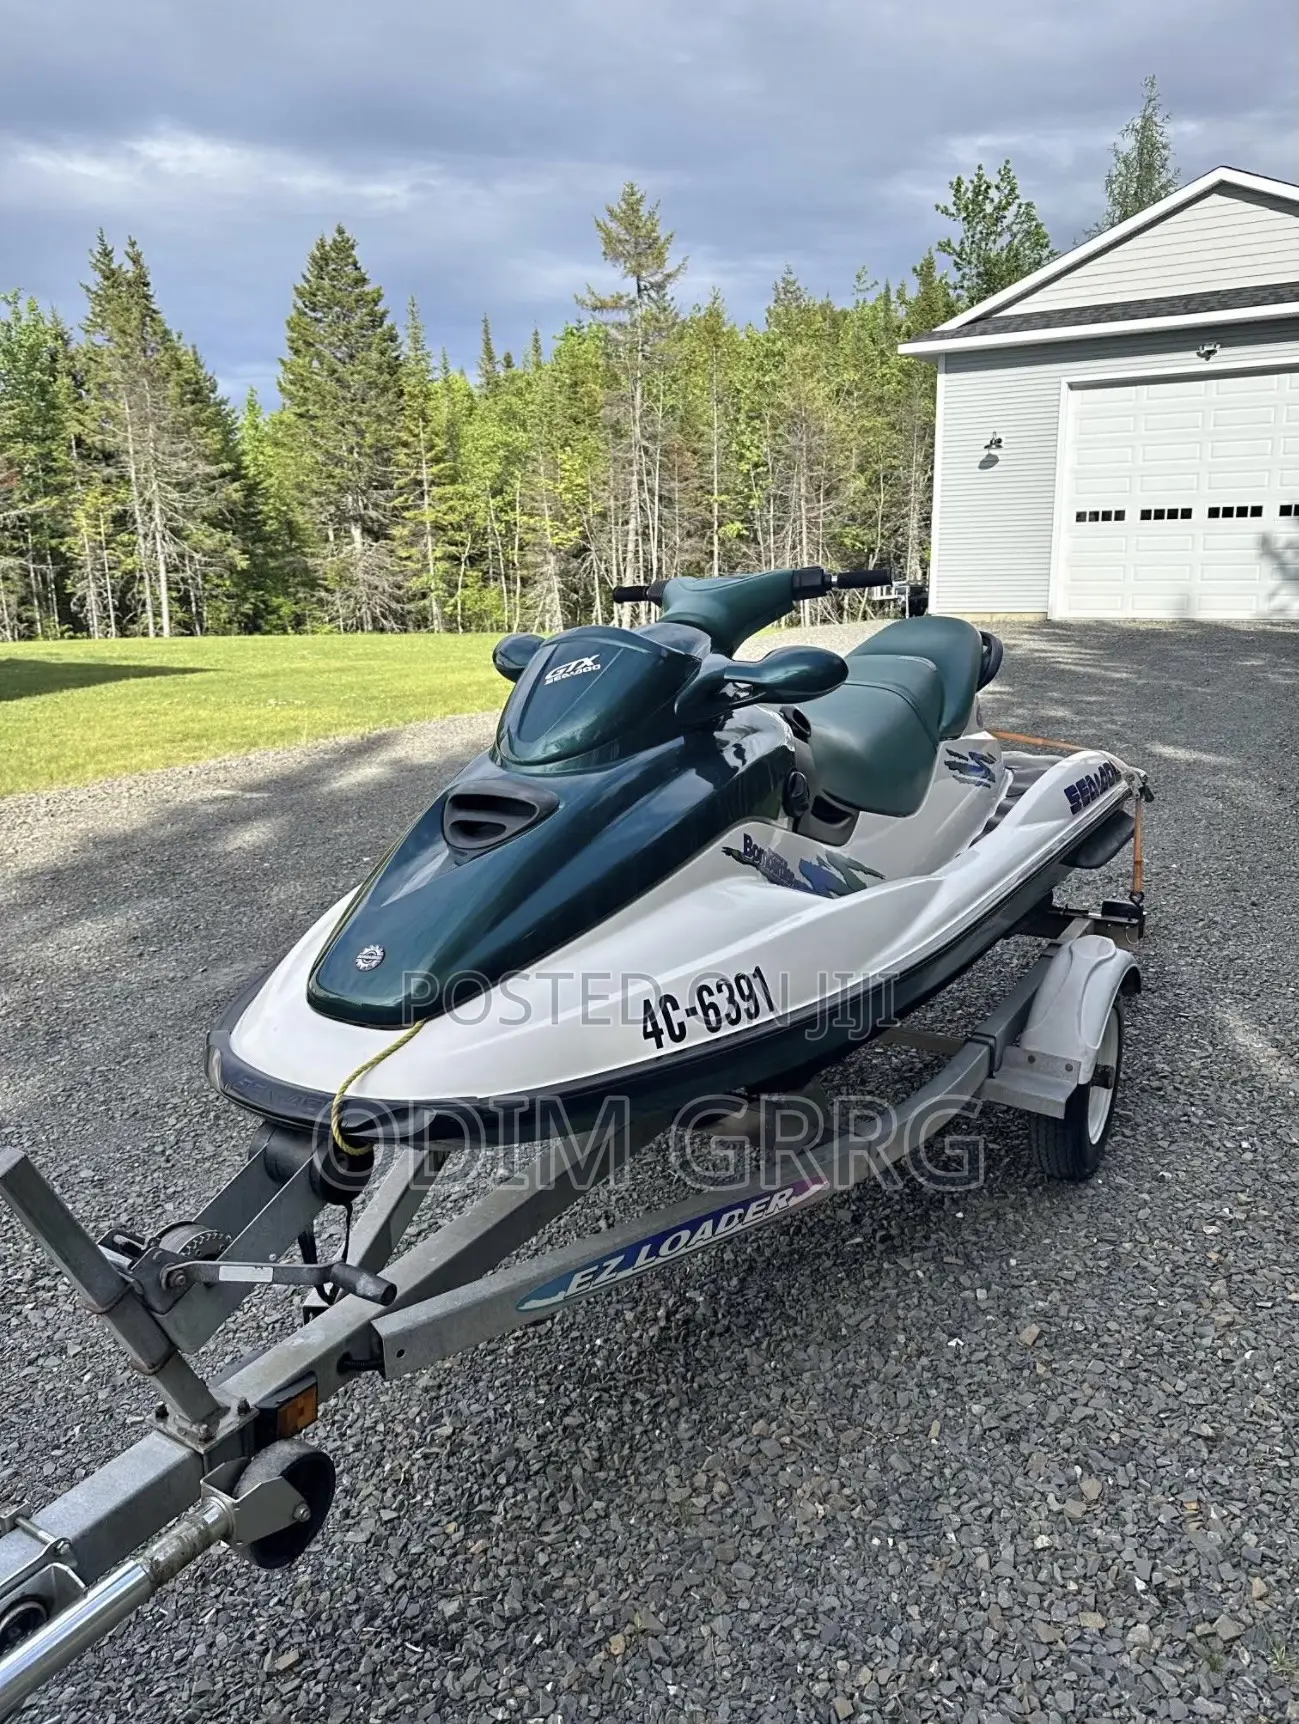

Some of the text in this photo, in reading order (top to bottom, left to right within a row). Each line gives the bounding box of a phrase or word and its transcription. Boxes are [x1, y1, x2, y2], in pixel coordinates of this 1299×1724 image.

[545, 654, 600, 680] GTX
[642, 965, 777, 1050] 4C-6391
[564, 1187, 795, 1298] EZ LOADER
